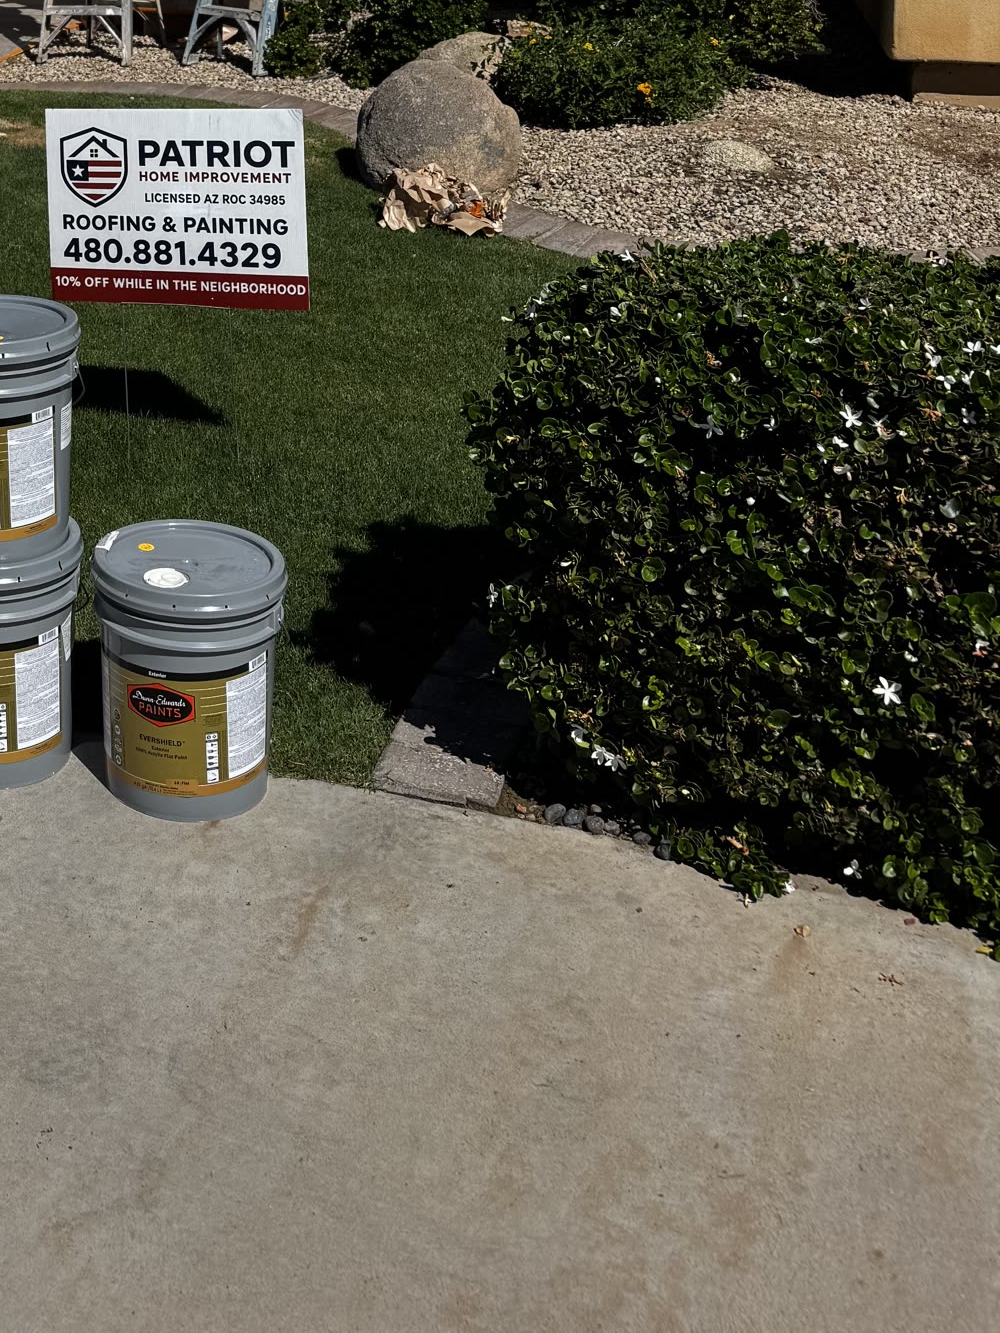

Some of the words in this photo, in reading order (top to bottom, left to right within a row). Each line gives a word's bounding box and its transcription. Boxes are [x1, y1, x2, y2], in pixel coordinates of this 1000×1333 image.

[138, 140, 295, 168] PATRIOT
[139, 171, 179, 182] HOME
[184, 172, 291, 184] IMPROVEMENT
[144, 193, 200, 204] LICENSED
[203, 194, 219, 204] AZ
[222, 195, 246, 205] ROC
[249, 195, 286, 206] 34985
[63, 214, 156, 232] ROOFING
[162, 217, 177, 233] &
[183, 218, 288, 235] PAINTING
[64, 238, 282, 269] 480.881.4329
[55, 276, 81, 287] 10%
[84, 277, 110, 288] OFF
[113, 278, 153, 290] WHILE
[156, 279, 170, 290] IN
[172, 280, 197, 291] THE
[200, 281, 306, 296] NEIGHBORHOOD
[138, 701, 181, 718] PAINTS
